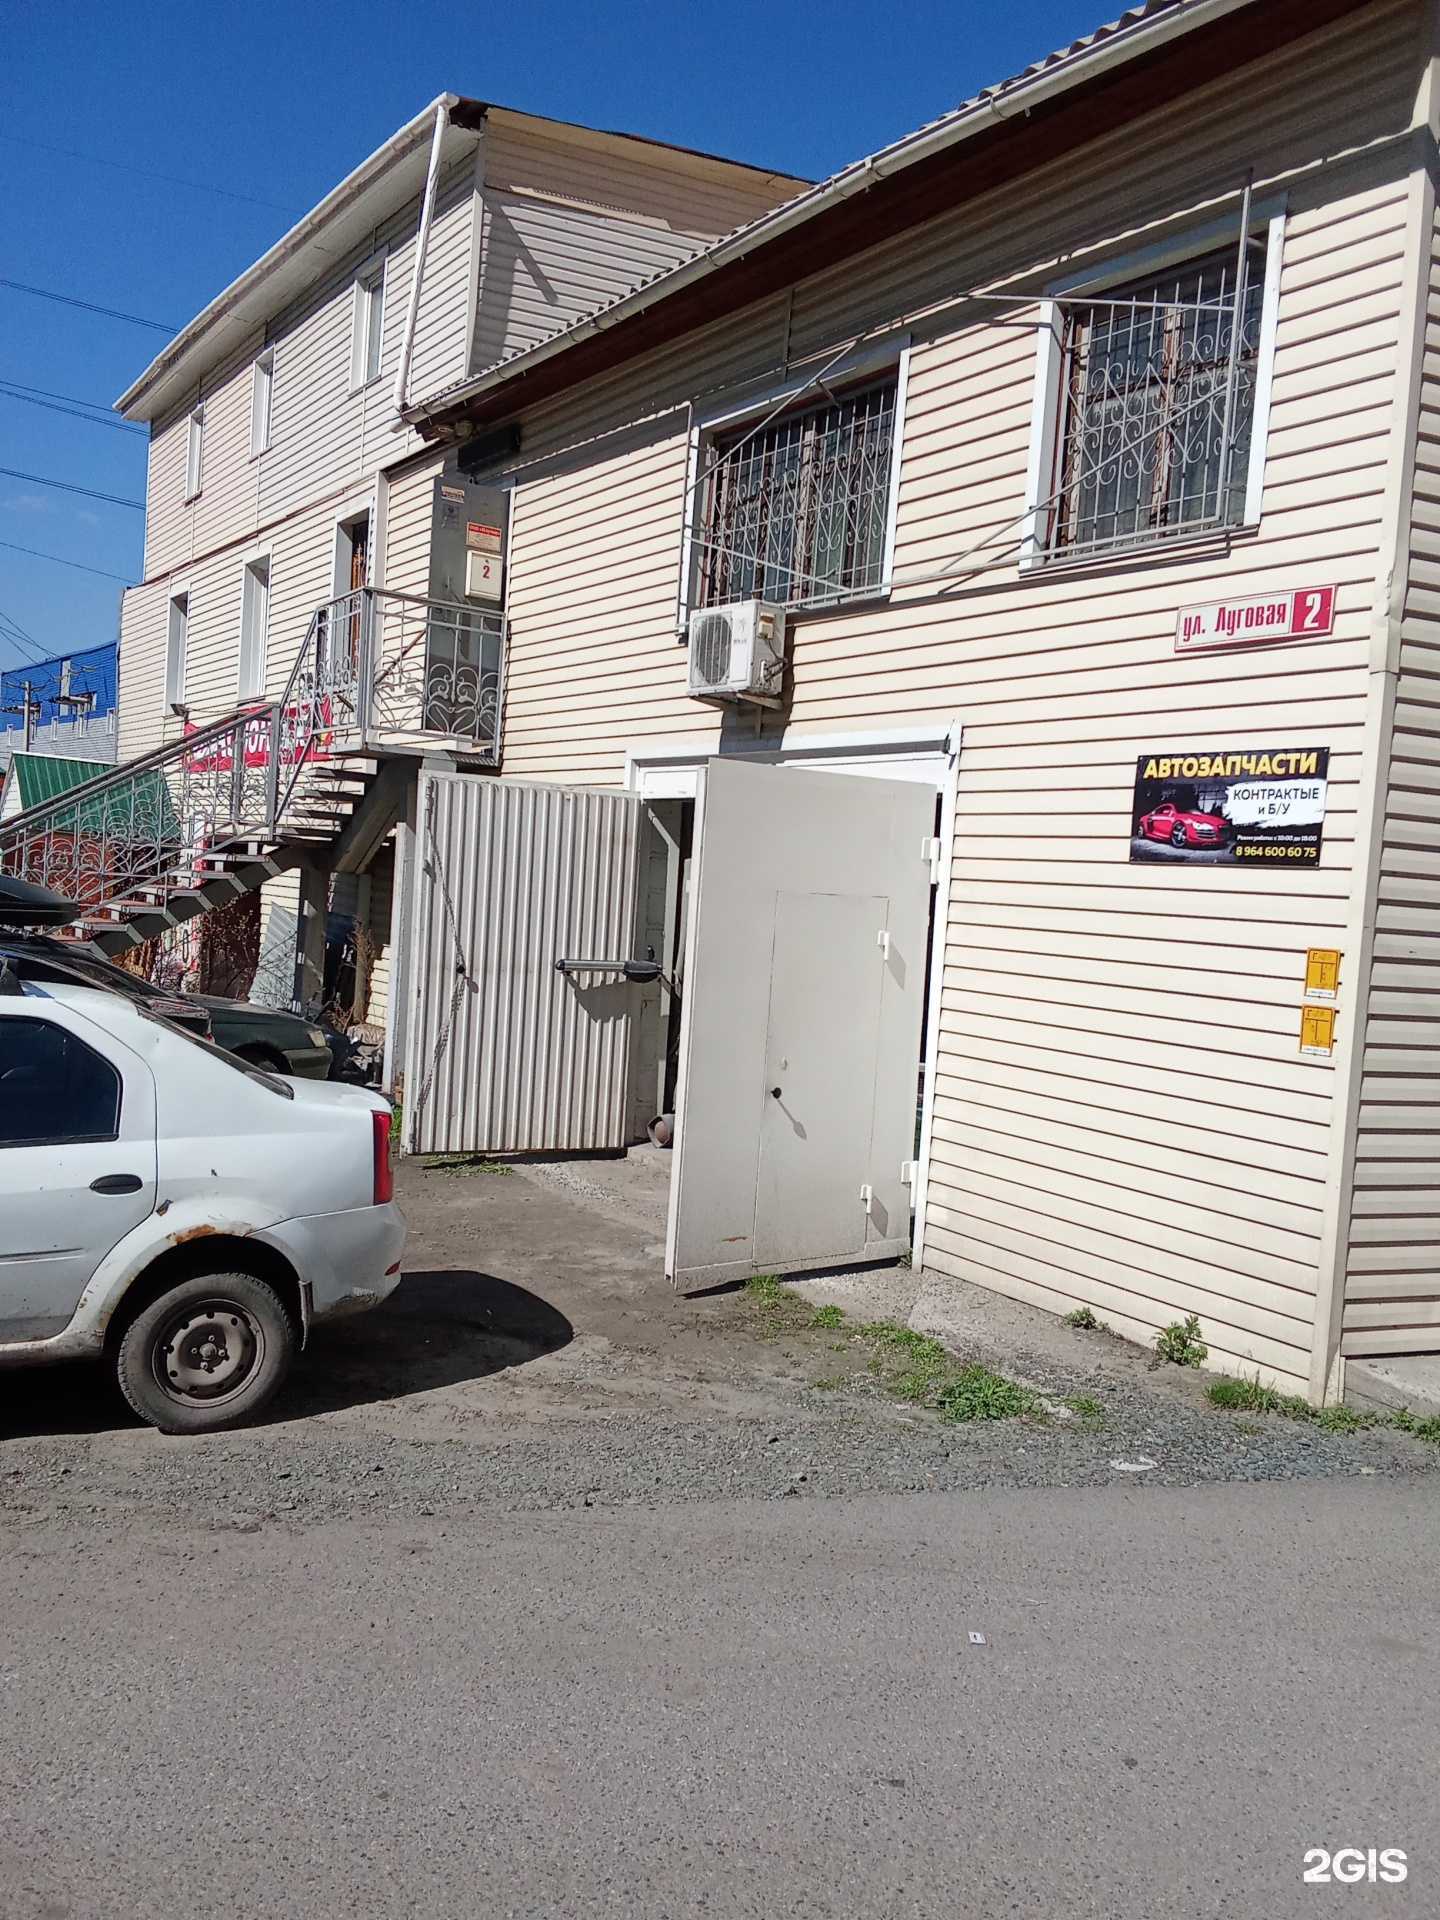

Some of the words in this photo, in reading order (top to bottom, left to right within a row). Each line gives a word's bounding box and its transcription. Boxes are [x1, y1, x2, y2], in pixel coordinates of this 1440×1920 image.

[482, 565, 490, 579] 2
[1183, 615, 1206, 642] ул.
[1215, 603, 1288, 636] Луговая
[1303, 592, 1322, 629] 2
[1143, 752, 1318, 779] АВТОЗАПЧАСТИ
[1233, 788, 1320, 800] КОНТРАКТЫЕ
[1268, 803, 1291, 815] Б/У
[1235, 846, 1243, 857] 8
[1244, 846, 1263, 857] 964
[1265, 847, 1286, 857] 600
[1287, 847, 1302, 857] 60
[1303, 847, 1317, 858] 75
